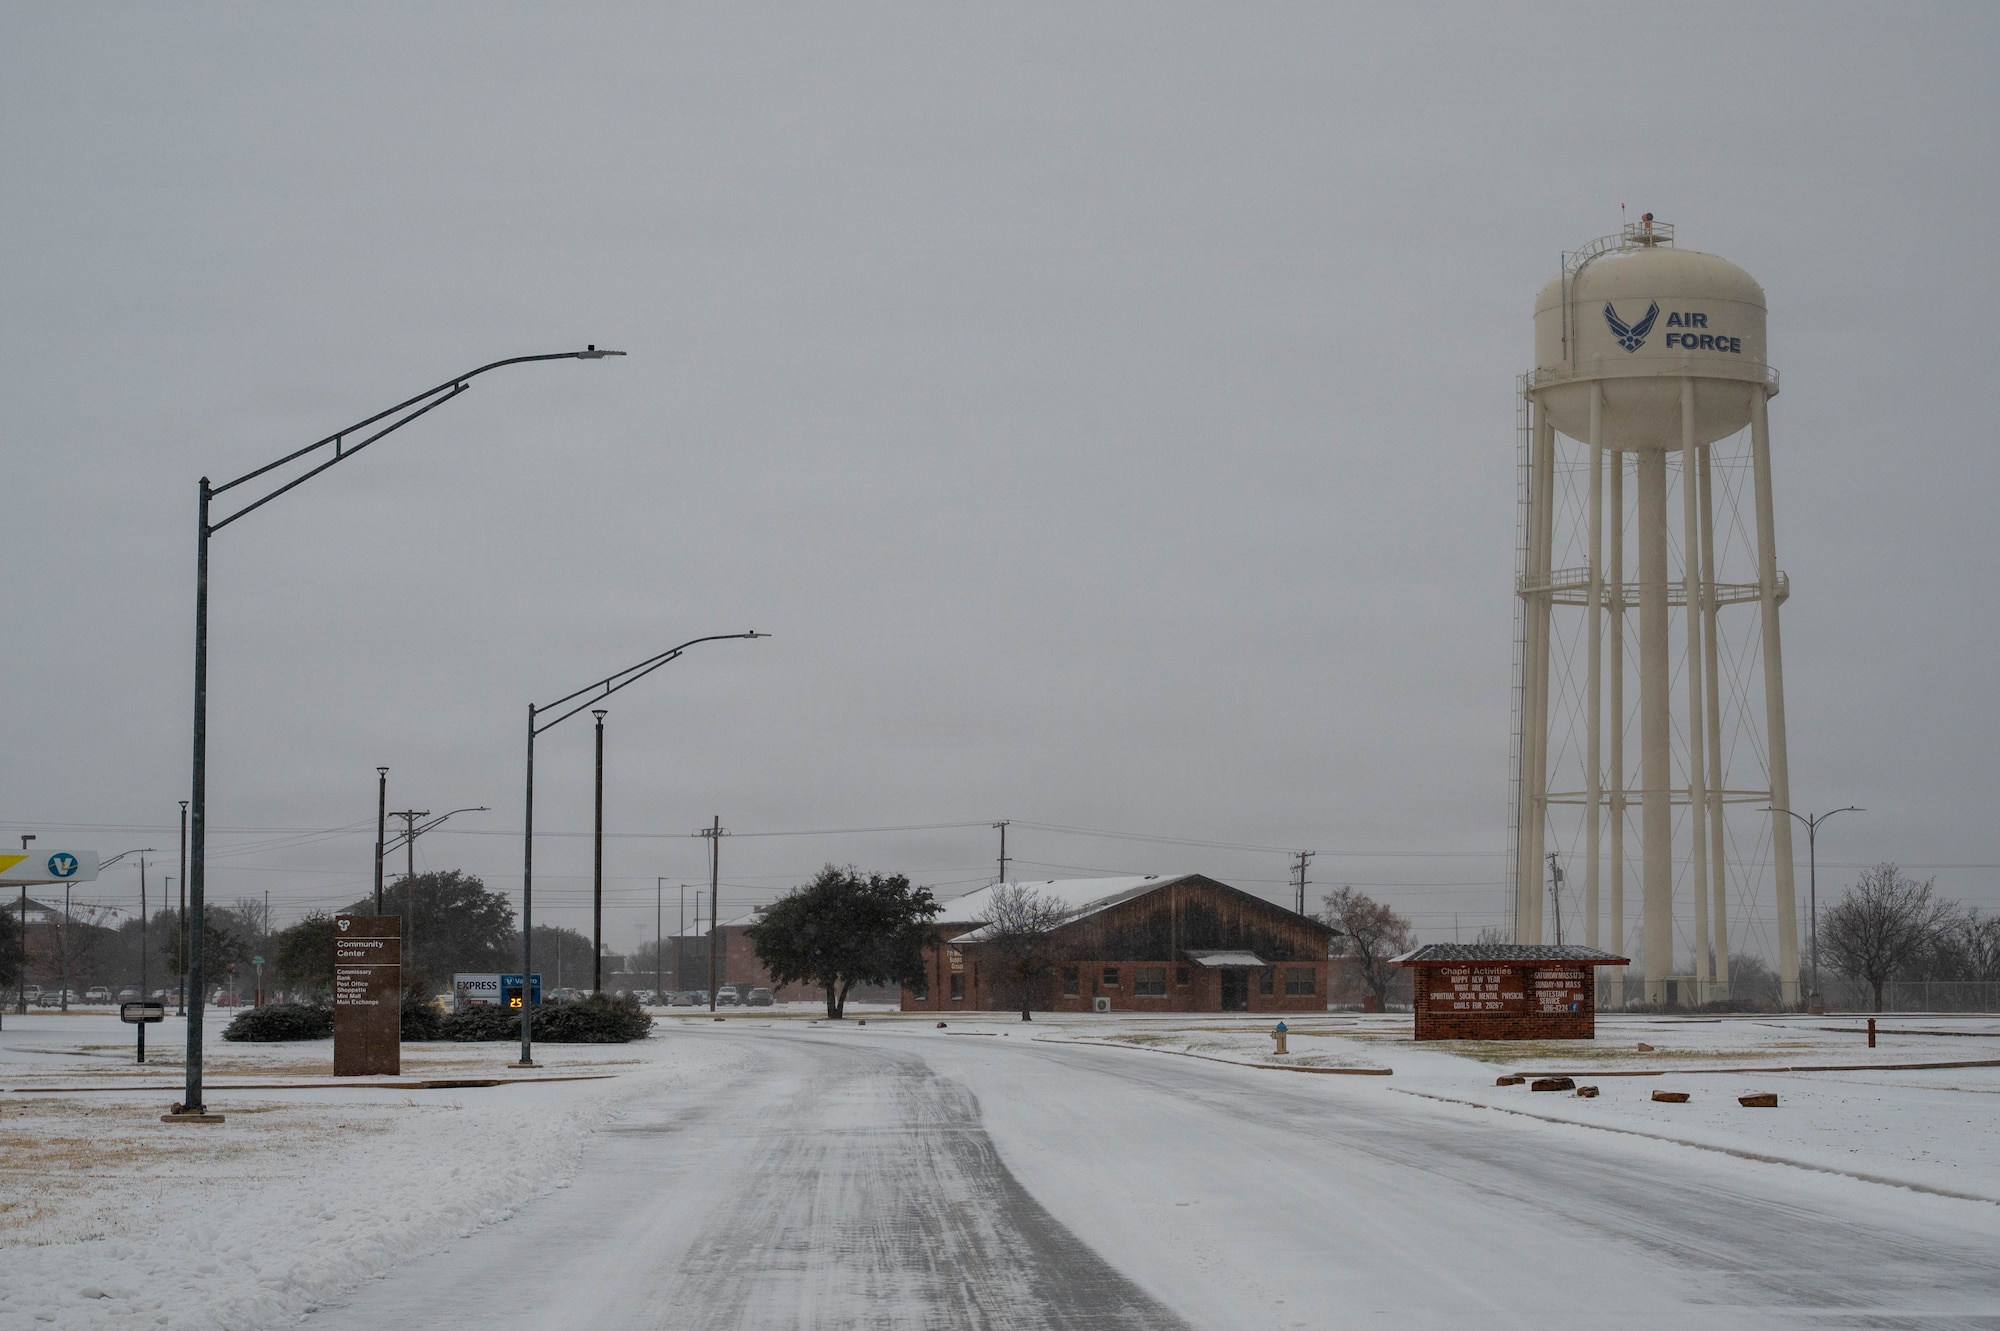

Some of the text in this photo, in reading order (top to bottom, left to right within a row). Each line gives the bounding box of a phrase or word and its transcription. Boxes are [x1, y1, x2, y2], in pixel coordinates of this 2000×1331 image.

[1666, 312, 1708, 328] AIR
[1666, 333, 1741, 353] FORCE
[53, 857, 73, 875] V
[1441, 967, 1512, 976] Chapel Activities
[457, 982, 497, 990] EXPRESS
